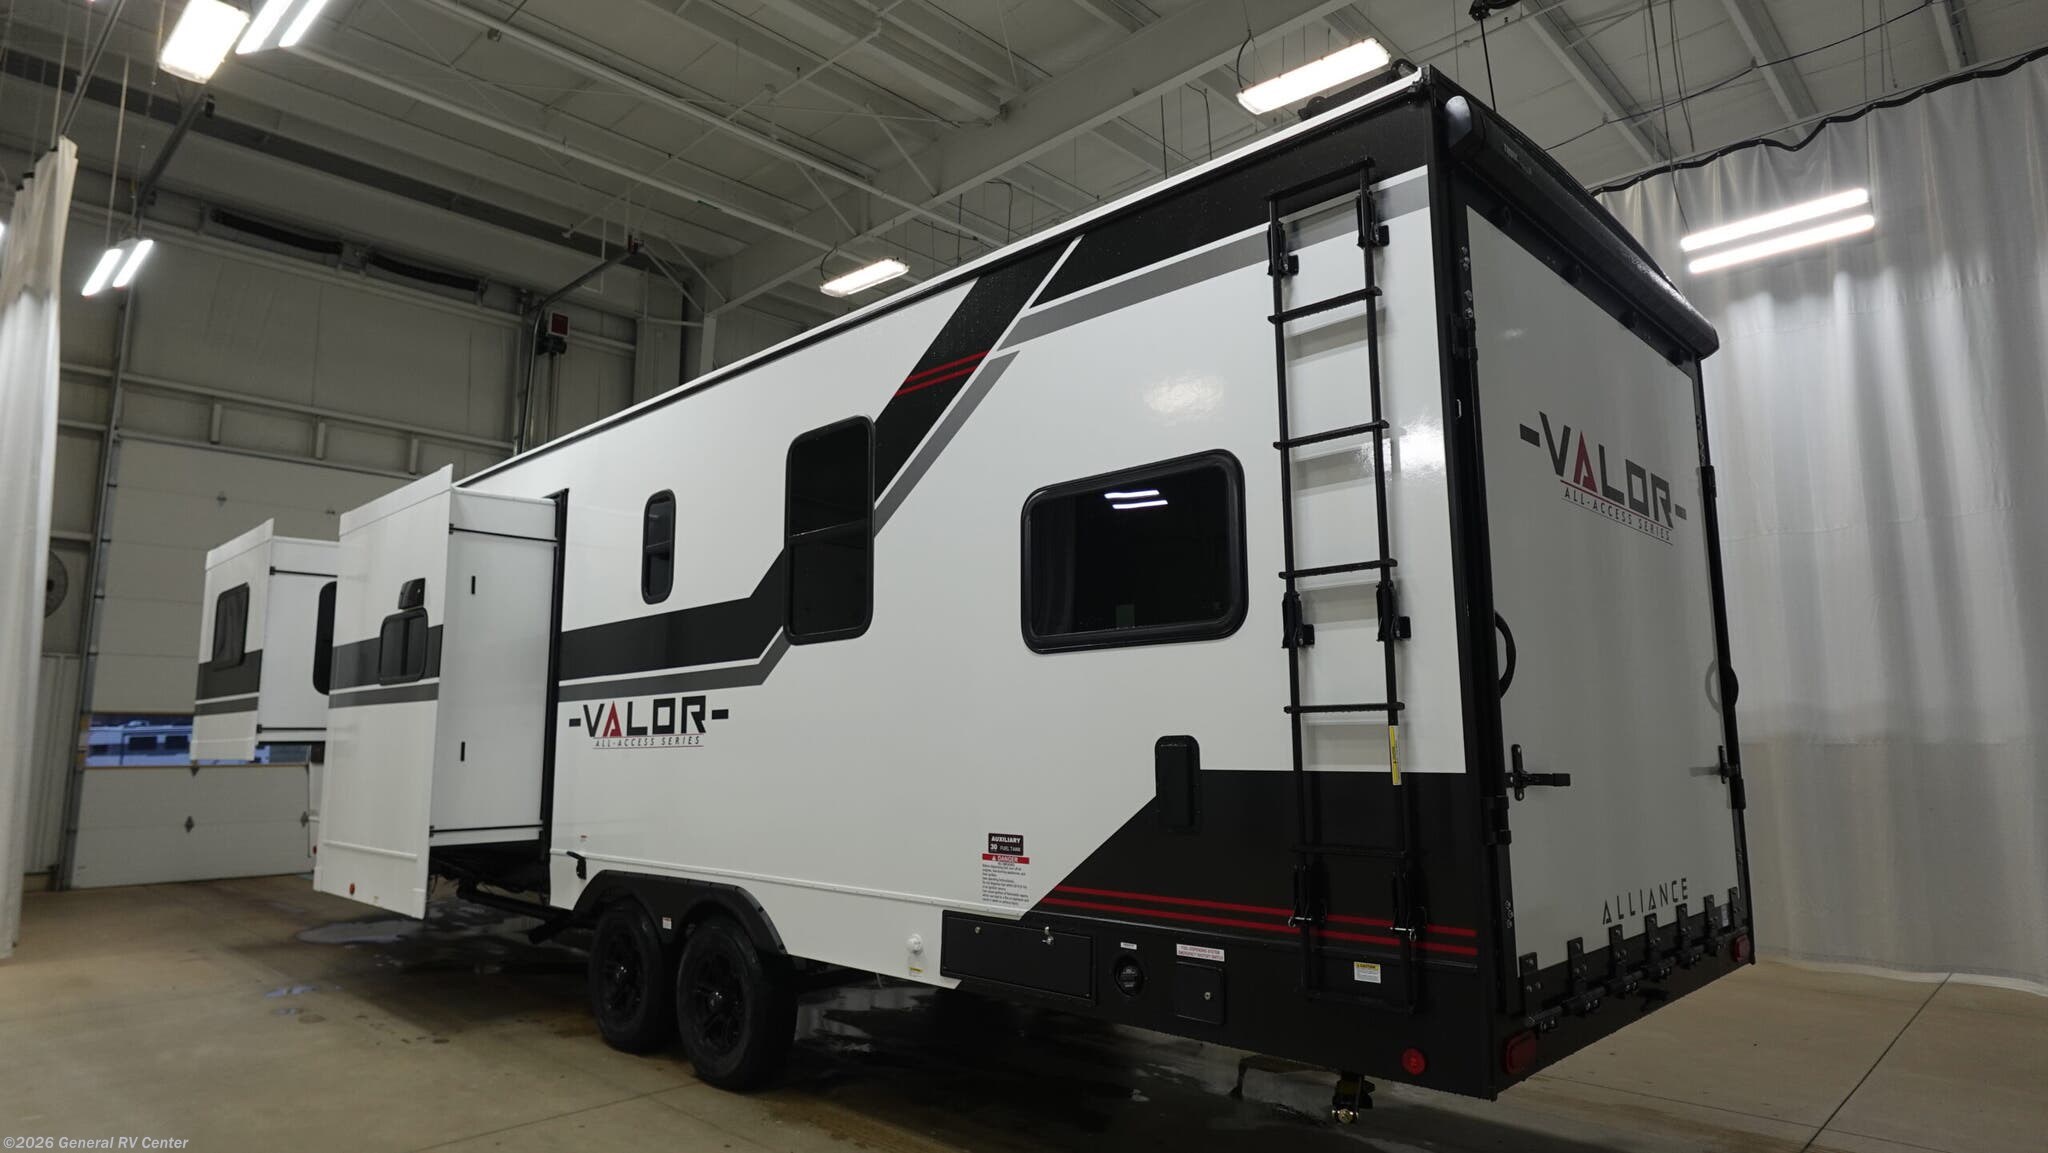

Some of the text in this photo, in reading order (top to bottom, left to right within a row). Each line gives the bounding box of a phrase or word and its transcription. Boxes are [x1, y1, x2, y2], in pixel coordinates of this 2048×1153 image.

[1564, 487, 1671, 542] ALL-ACCESS SERIES
[595, 735, 700, 748] ALL-ACCESS SERIES
[991, 836, 1021, 844] AUXILIARY
[1602, 877, 1689, 925] ALLIANCE
